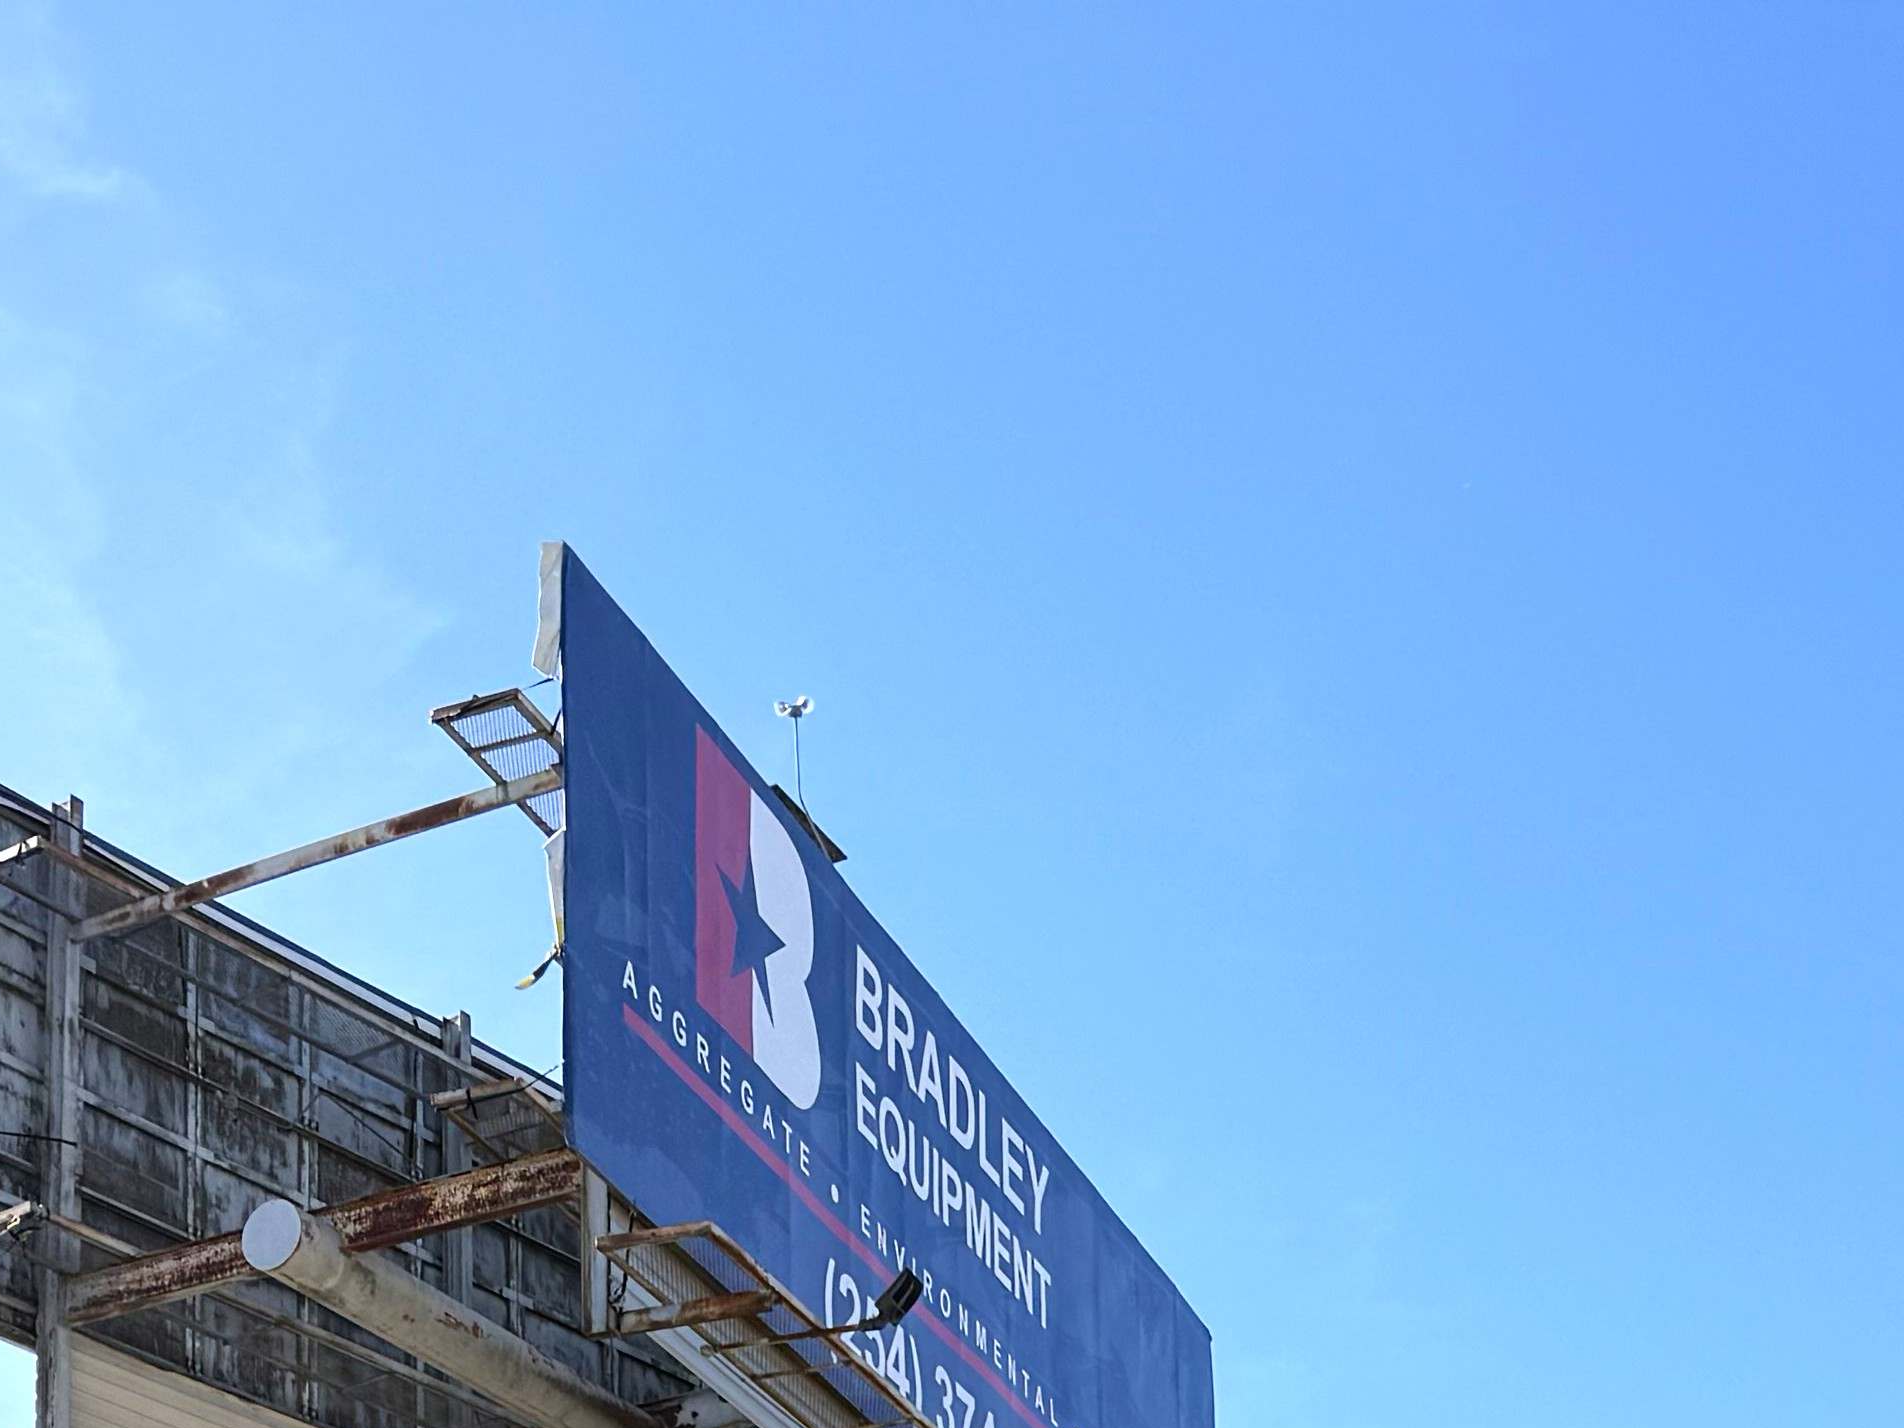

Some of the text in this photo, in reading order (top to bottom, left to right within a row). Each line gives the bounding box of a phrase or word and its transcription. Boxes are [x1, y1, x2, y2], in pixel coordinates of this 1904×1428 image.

[622, 960, 811, 1177] AGGREGATE
[860, 1203, 1059, 1428] ENVIRONMENTAL
[855, 1061, 1052, 1330] EQUIPMENT
[856, 944, 1050, 1236] BRADLEY
